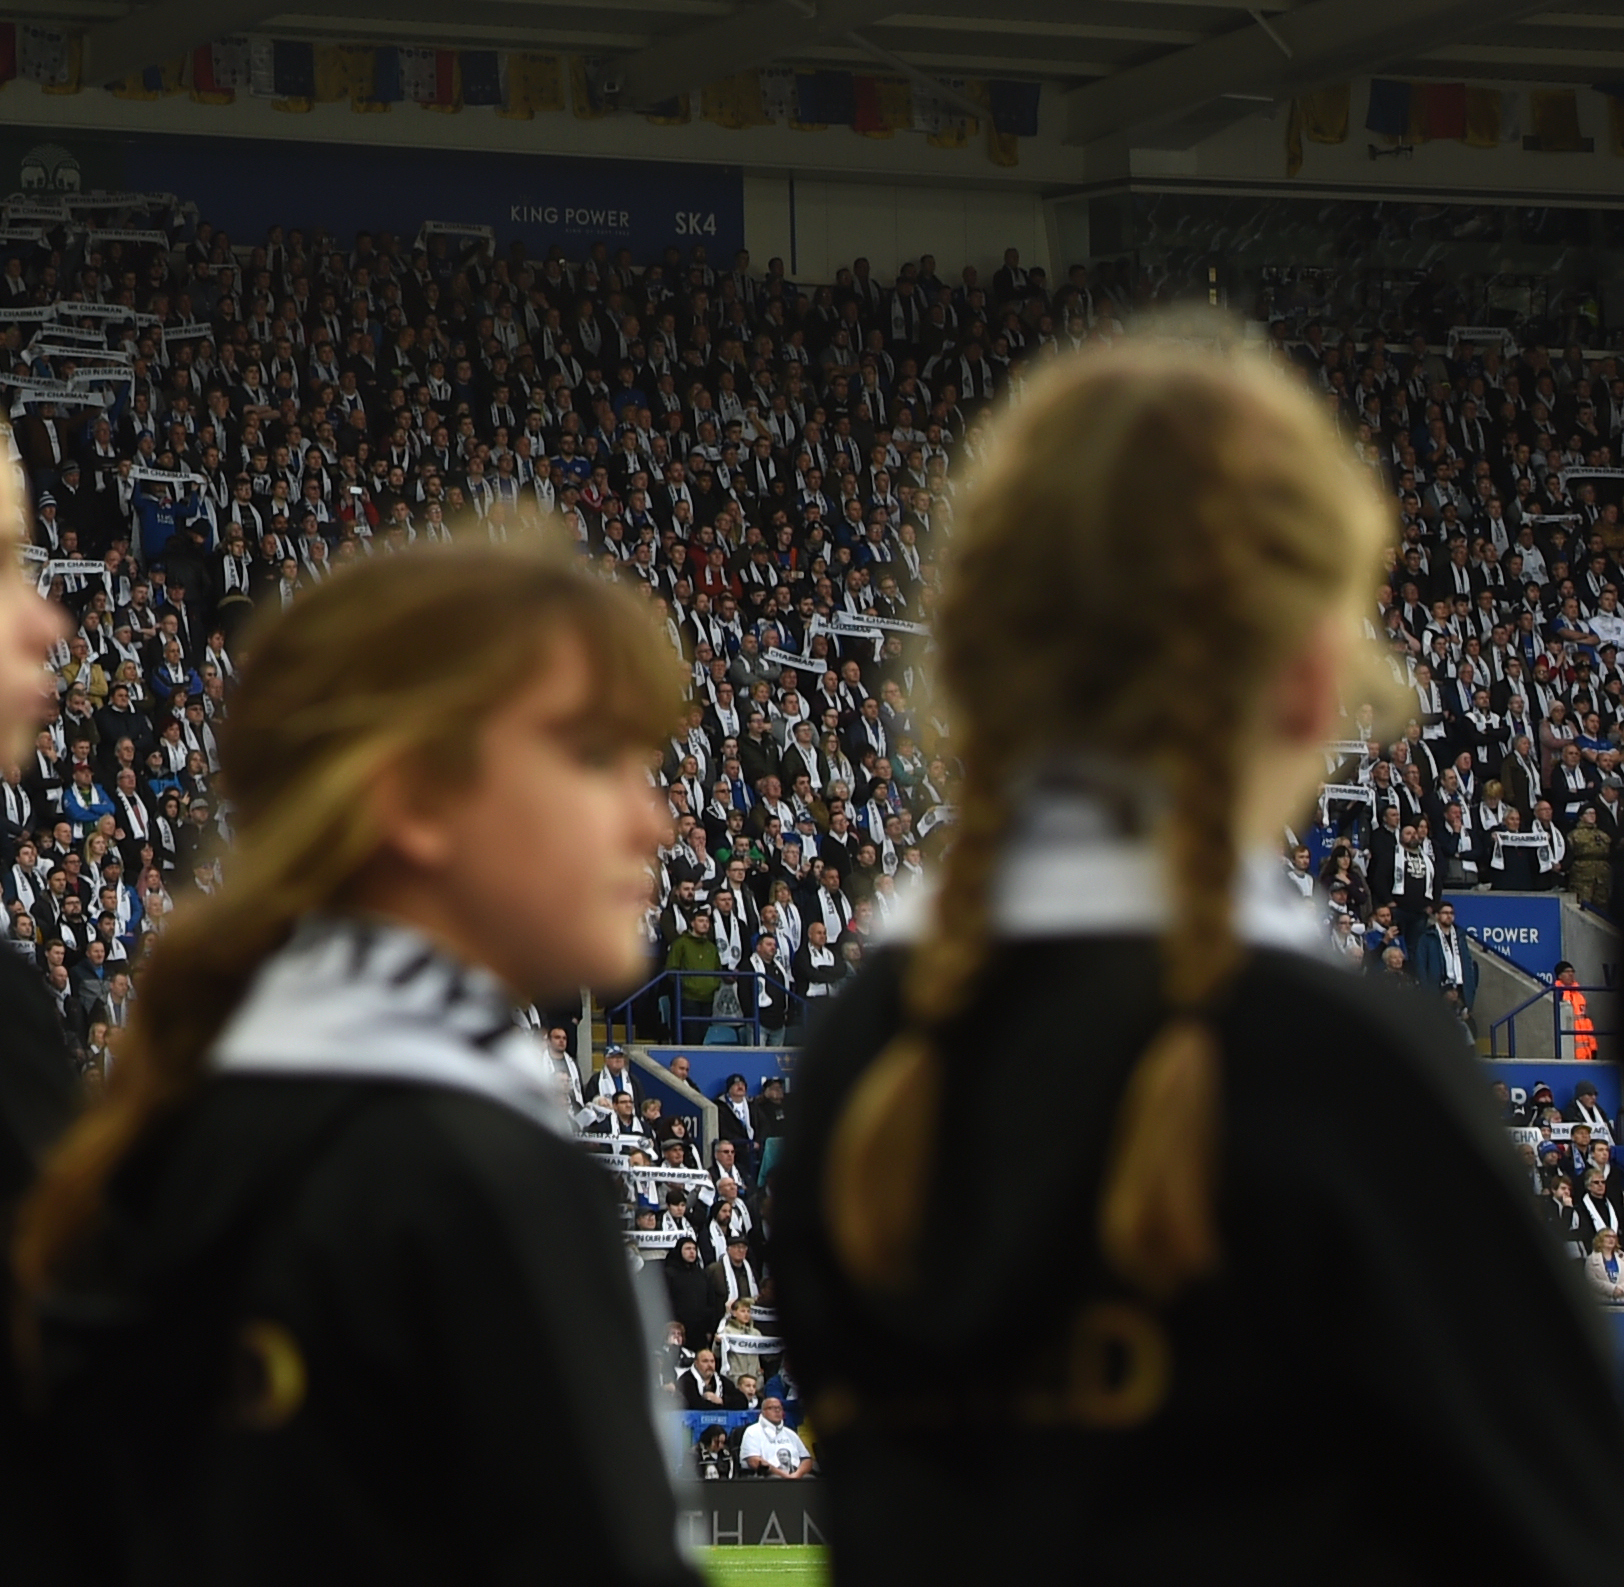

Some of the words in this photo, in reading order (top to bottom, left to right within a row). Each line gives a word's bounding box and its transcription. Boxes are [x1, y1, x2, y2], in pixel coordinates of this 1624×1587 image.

[510, 205, 559, 224] KING
[565, 208, 630, 229] POWER
[675, 211, 717, 236] SK4
[67, 561, 103, 569] CHAIRMA
[1482, 926, 1539, 945] POWER
